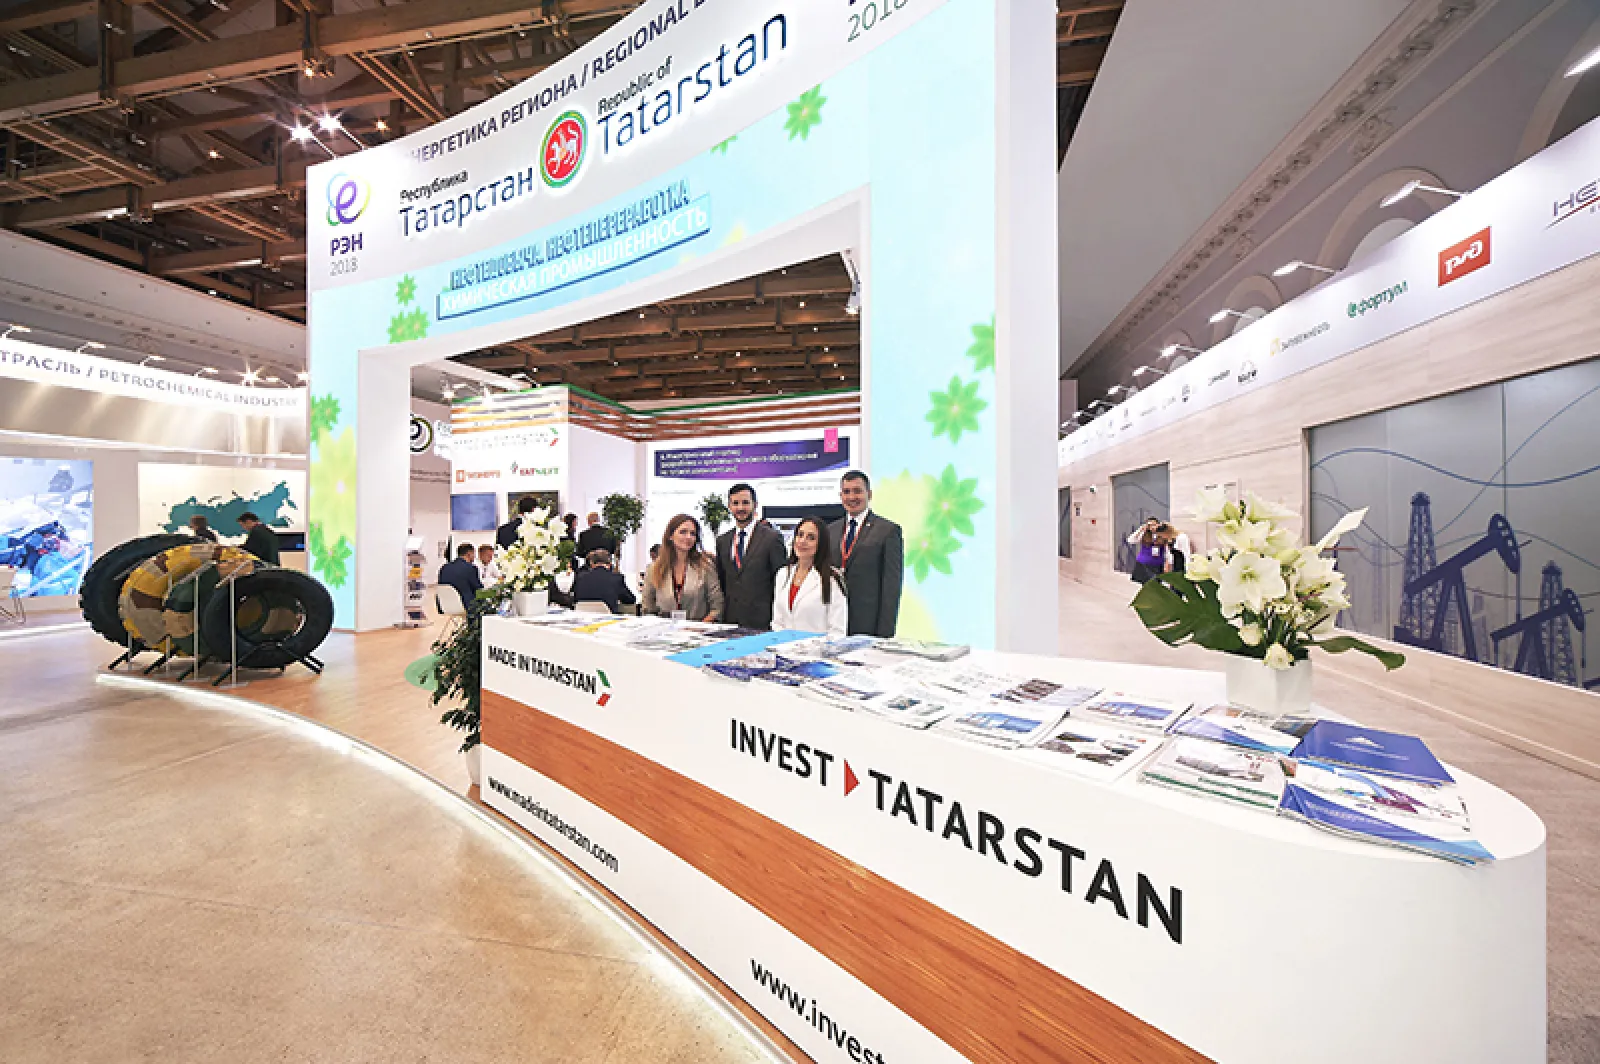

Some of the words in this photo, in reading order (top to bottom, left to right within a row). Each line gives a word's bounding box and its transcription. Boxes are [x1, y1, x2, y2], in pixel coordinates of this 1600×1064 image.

[411, 121, 498, 164] НЕРГЕТИКА
[501, 72, 578, 129] РЕГИОНА
[592, 0, 689, 79] REGIONAL
[597, 13, 787, 155] Tatarstan
[597, 70, 654, 115] Republic
[657, 56, 673, 79] of
[399, 167, 533, 237] Татарстан
[400, 169, 468, 203] Республика
[330, 231, 363, 256] РЭН
[330, 256, 359, 276] 2018
[442, 273, 537, 312] ХИМИЧЕСКАЯ
[541, 207, 707, 288] ПРОМЫШЛЕННОСТЬ
[100, 368, 231, 402] PETROCHEMICAL
[488, 645, 516, 669] MADE
[518, 653, 530, 673] IN
[531, 657, 596, 694] TATARSTAN
[488, 775, 619, 873] www.madeintatarstan.com
[731, 718, 834, 786] INVEST
[868, 769, 1183, 945] TATARSTAN
